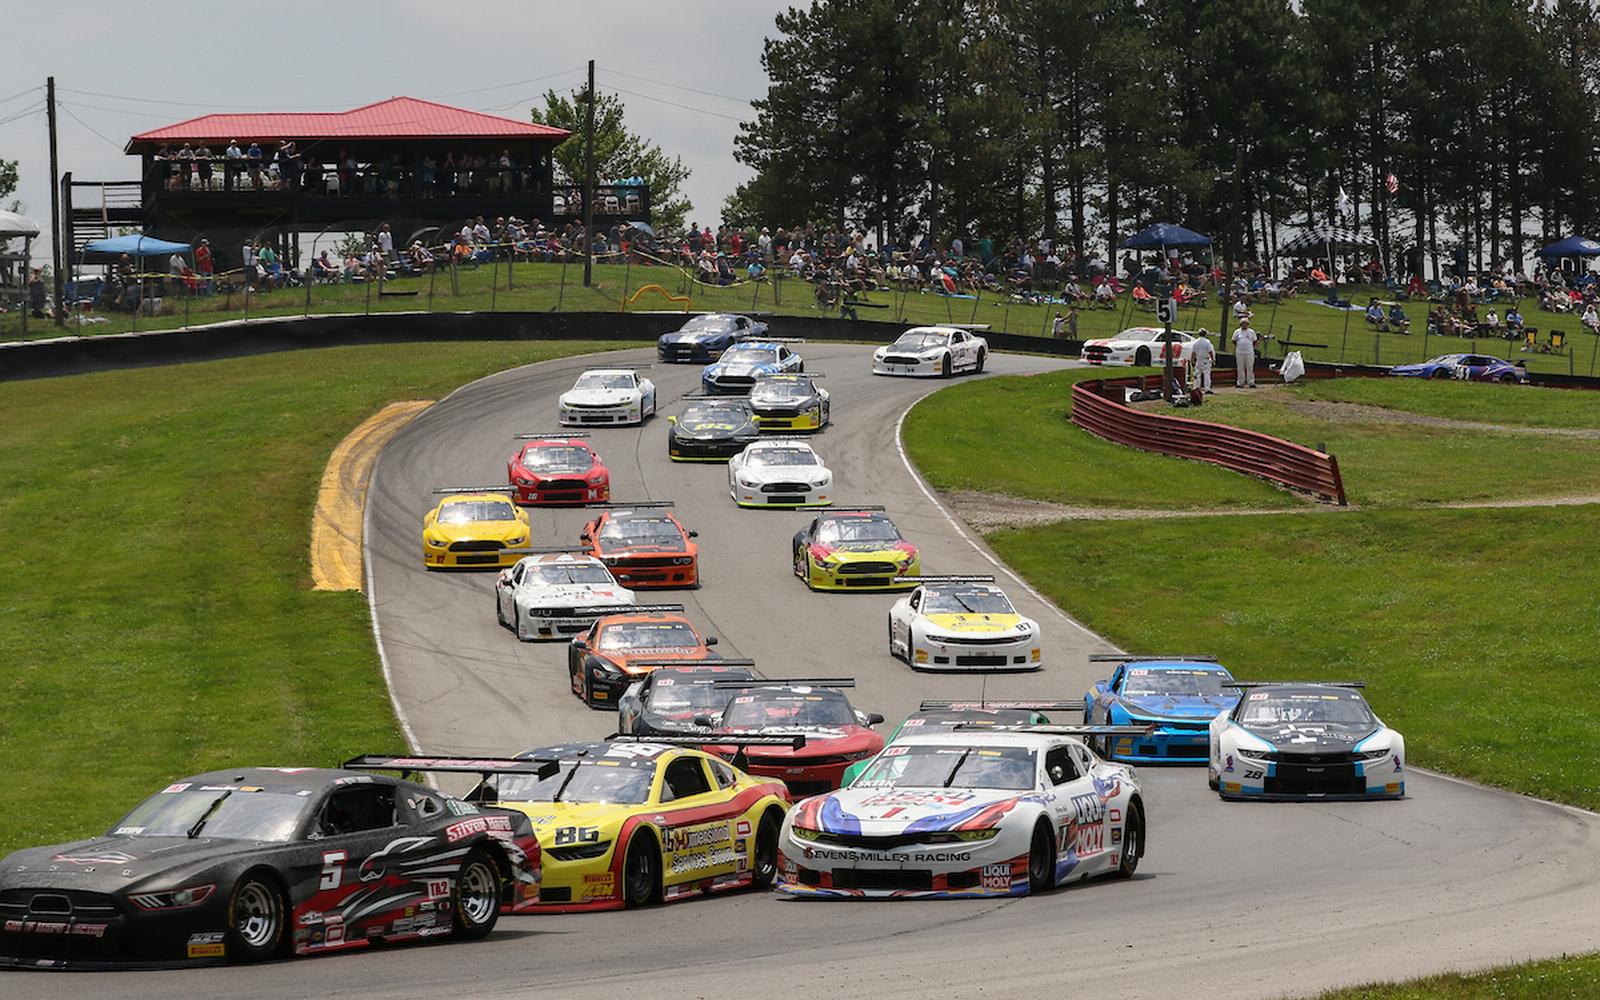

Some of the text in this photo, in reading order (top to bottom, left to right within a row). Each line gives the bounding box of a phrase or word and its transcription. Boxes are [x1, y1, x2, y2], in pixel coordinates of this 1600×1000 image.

[1159, 299, 1171, 322] 5
[588, 490, 597, 499] M
[1244, 769, 1263, 780] 28
[446, 818, 487, 843] Silver
[555, 826, 599, 846] 86
[915, 852, 970, 862] RACING
[321, 851, 345, 891] 5
[984, 866, 1010, 876] LIQUI
[430, 881, 448, 897] TA2
[984, 877, 1010, 888] MOLY
